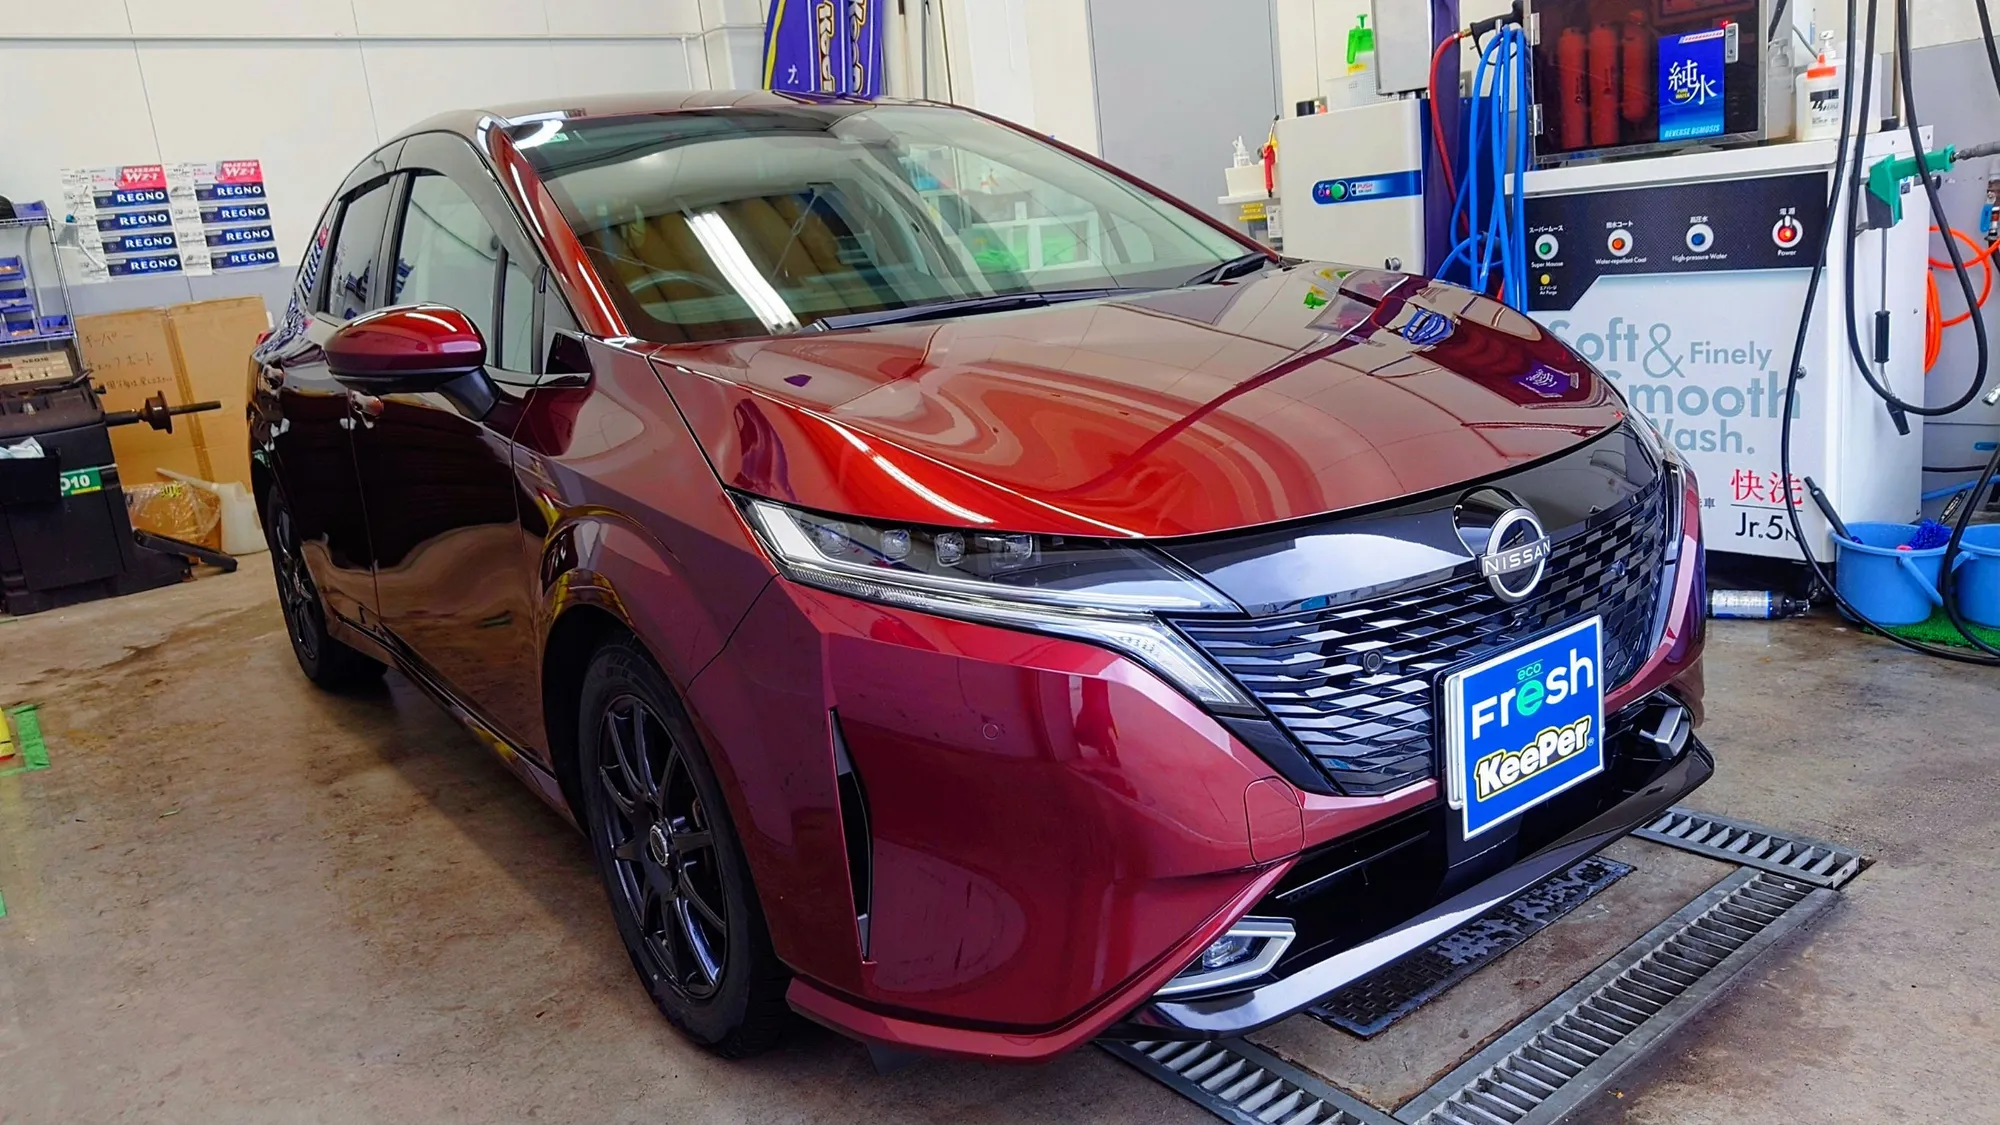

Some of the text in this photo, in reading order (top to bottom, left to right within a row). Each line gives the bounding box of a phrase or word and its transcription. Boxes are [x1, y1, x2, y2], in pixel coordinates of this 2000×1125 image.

[1668, 59, 1718, 105] 純水
[1664, 124, 1720, 138] REVERSE OSMOSIS
[117, 191, 165, 203] REGNO
[217, 185, 262, 196] REGNO
[221, 207, 266, 219] REGNO
[120, 214, 167, 226] REGNO
[226, 229, 270, 241] REGNO
[1529, 225, 1564, 233] スーパームース
[125, 236, 172, 249] REGNO
[231, 251, 275, 263] REGNO
[1595, 257, 1633, 265] Water-repellent
[1672, 252, 1727, 262] High-pressure Water
[130, 258, 178, 271] REGNO
[1642, 323, 1686, 379] &
[1690, 341, 1773, 371] Finely
[1604, 370, 1801, 419] mooth
[1730, 468, 1804, 505] 快洗
[1484, 539, 1551, 574] NISSAN
[1516, 662, 1542, 681] eco
[1472, 648, 1594, 741] Fresh
[1475, 717, 1592, 801] KeePer
